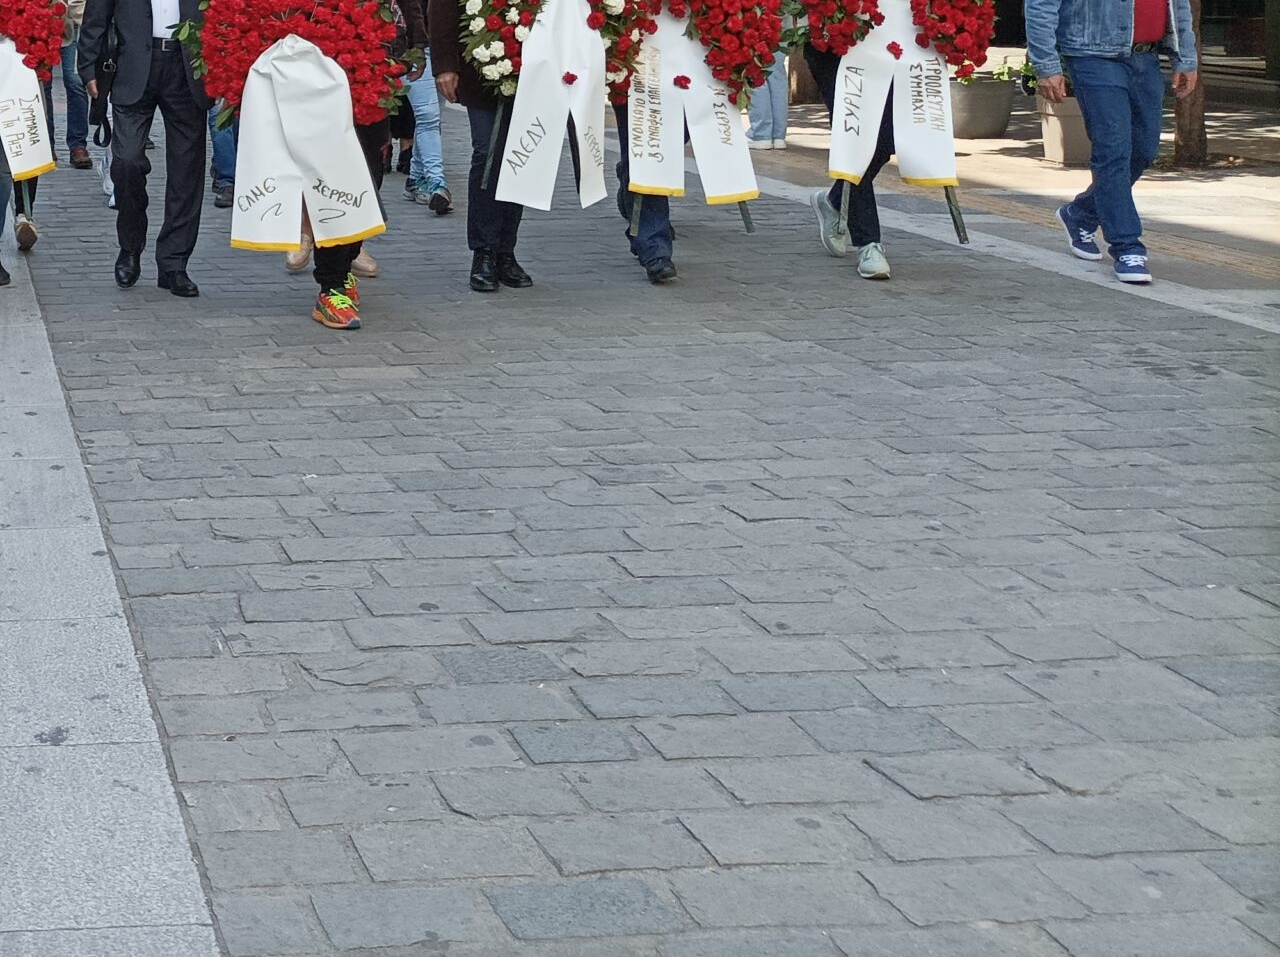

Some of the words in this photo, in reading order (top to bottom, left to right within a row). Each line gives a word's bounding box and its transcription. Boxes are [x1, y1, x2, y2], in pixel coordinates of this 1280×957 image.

[18, 93, 41, 147] ΣΥΜΜΑΧΙΑ
[843, 65, 865, 137] ΣΥΡΙΖΑ
[909, 62, 927, 124] ΣΥΜΜΑΧΙΑ
[505, 116, 547, 176] ΑΔΕΔΥ
[237, 177, 277, 213] ΕΛΜΕ
